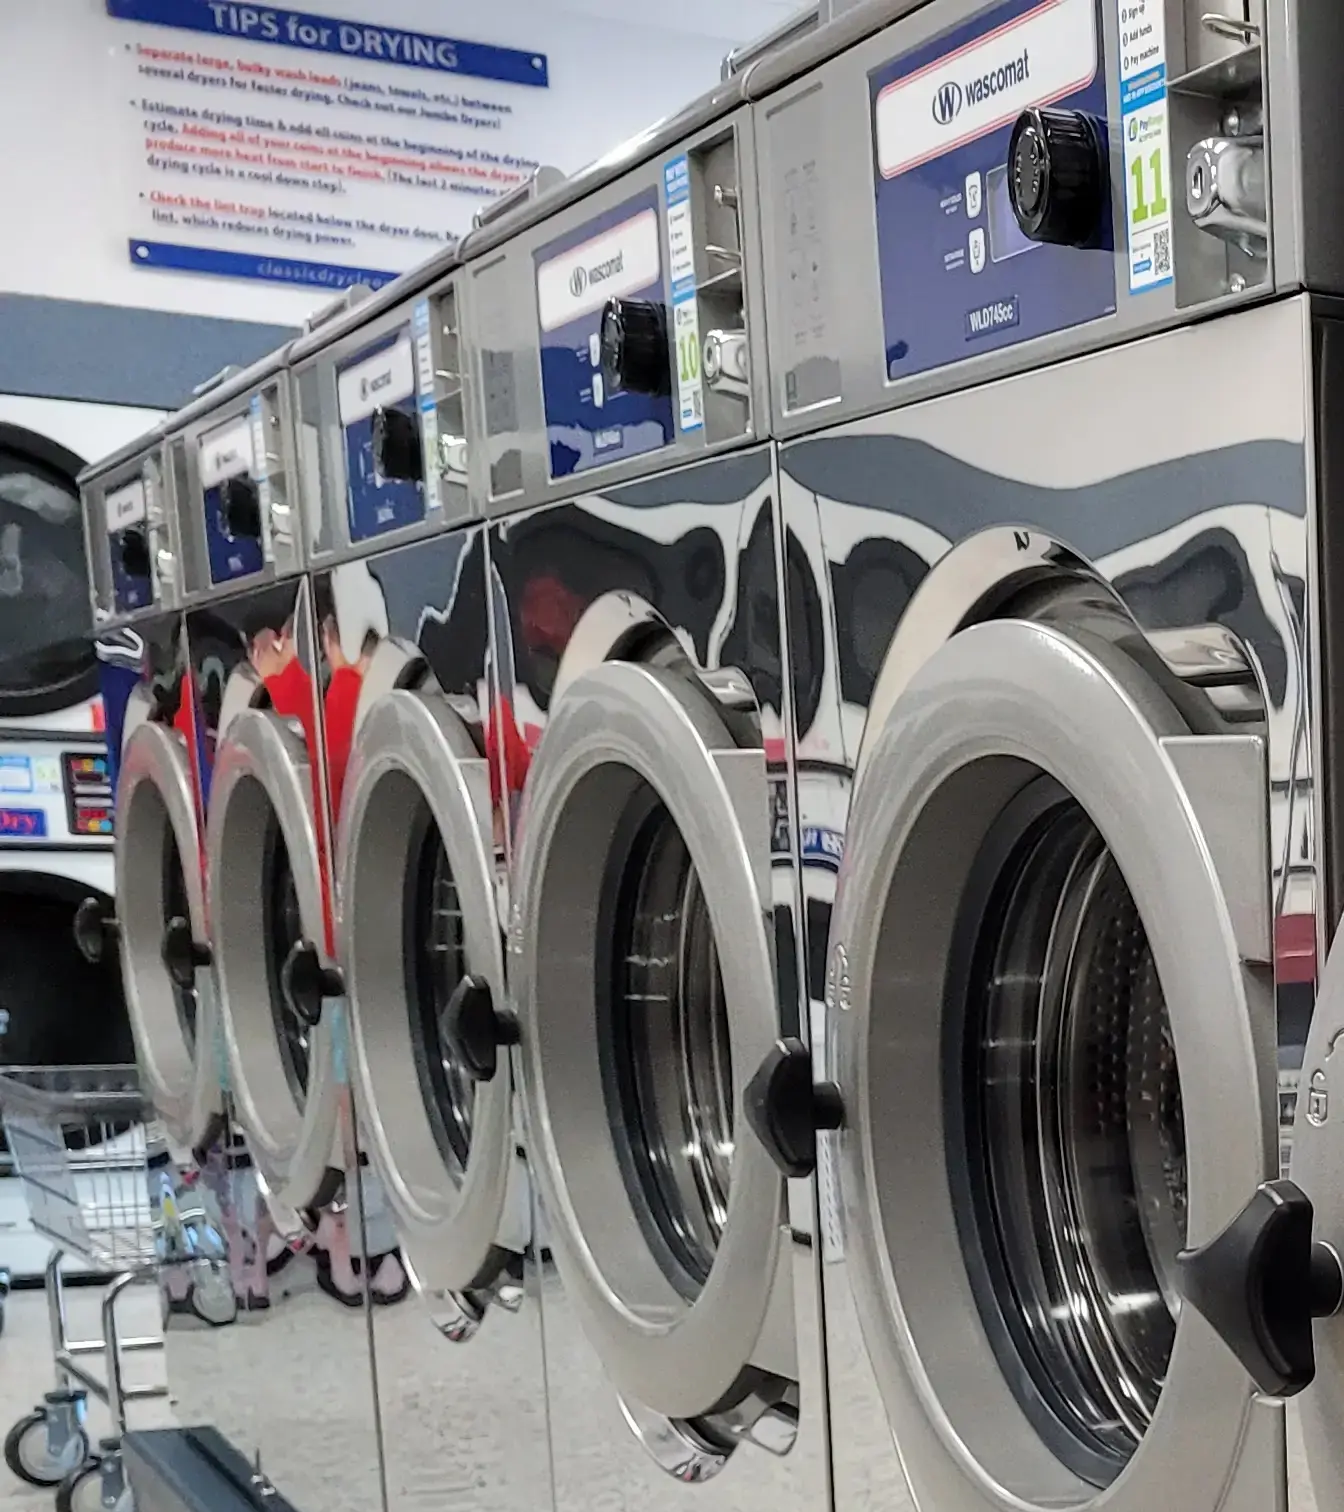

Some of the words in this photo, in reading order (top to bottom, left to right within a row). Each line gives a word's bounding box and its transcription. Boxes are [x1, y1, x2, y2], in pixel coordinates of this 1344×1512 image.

[208, 3, 279, 39] TIPS
[287, 15, 333, 46] for
[338, 25, 460, 68] DRYING
[1129, 28, 1138, 42] Add
[136, 43, 193, 64] Separate
[1130, 55, 1138, 66] Pay
[1140, 45, 1160, 60] machine
[187, 70, 227, 88] dryers
[230, 75, 247, 90] for
[964, 48, 1029, 107] wascomat
[142, 98, 198, 118] Estimate
[202, 108, 243, 127] drying
[381, 137, 400, 148] the
[404, 139, 463, 160] beginning
[481, 152, 499, 163] the
[147, 154, 189, 173] drying
[1131, 148, 1167, 223] 11
[588, 249, 624, 287] wascomat
[969, 302, 1013, 333] WLD745cc
[680, 331, 699, 382] 10
